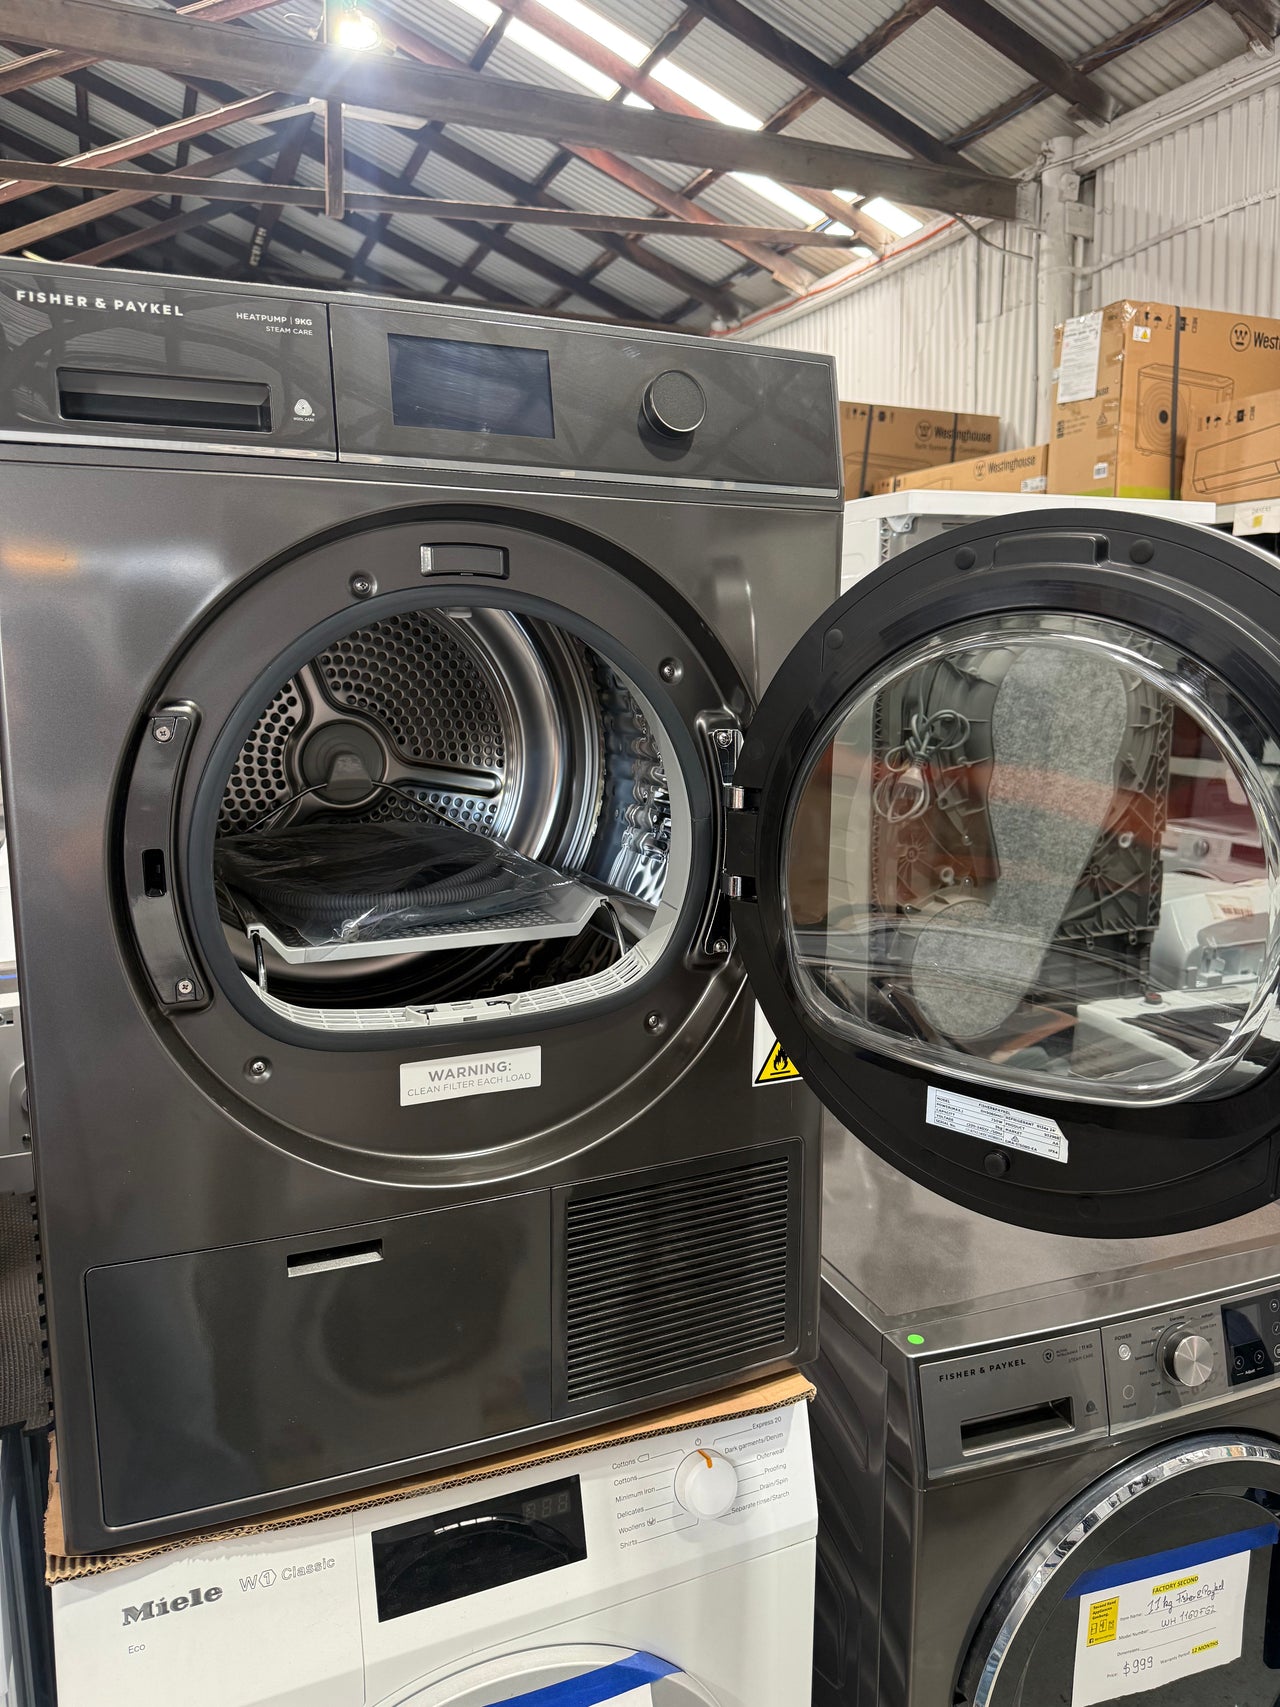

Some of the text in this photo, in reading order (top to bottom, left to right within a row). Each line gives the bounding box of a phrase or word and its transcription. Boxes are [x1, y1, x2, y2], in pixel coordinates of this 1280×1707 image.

[16, 290, 184, 316] FISHER & PAYKEL
[236, 312, 313, 326] HEATPUMP 9KG
[266, 326, 313, 336] STEAM CARE
[988, 455, 1036, 474] Westinghouse
[428, 1061, 512, 1082] WARNING:
[407, 1072, 531, 1097] CLEAN FILTER EACH LOAD
[1114, 1333, 1132, 1341] POWER
[939, 1368, 976, 1382] FISHER
[989, 1358, 1026, 1371] PAYKEL
[752, 1416, 782, 1430] Express 20
[724, 1432, 784, 1454] Dark garments/Denim
[756, 1448, 785, 1460] Outerwear
[612, 1458, 636, 1470] Cottons
[764, 1463, 787, 1474] Proofing
[613, 1475, 638, 1486] Cottons
[759, 1477, 789, 1490] Drain/Spin
[615, 1490, 643, 1503] Minimum
[731, 1491, 790, 1514] Separate rinse/Starch
[617, 1506, 645, 1519] Delicates
[618, 1522, 646, 1534] Woollens
[620, 1540, 638, 1549] Shirts
[281, 1557, 336, 1580] Classic
[1152, 1576, 1199, 1594] FACTORY SECOND
[121, 1585, 223, 1626] Miele
[1147, 1596, 1161, 1615] 11
[1163, 1595, 1173, 1614] kg
[1161, 1617, 1177, 1627] WH
[128, 1643, 146, 1654] Eco
[1198, 1640, 1219, 1652] MONTHS
[1123, 1656, 1153, 1677] $999
